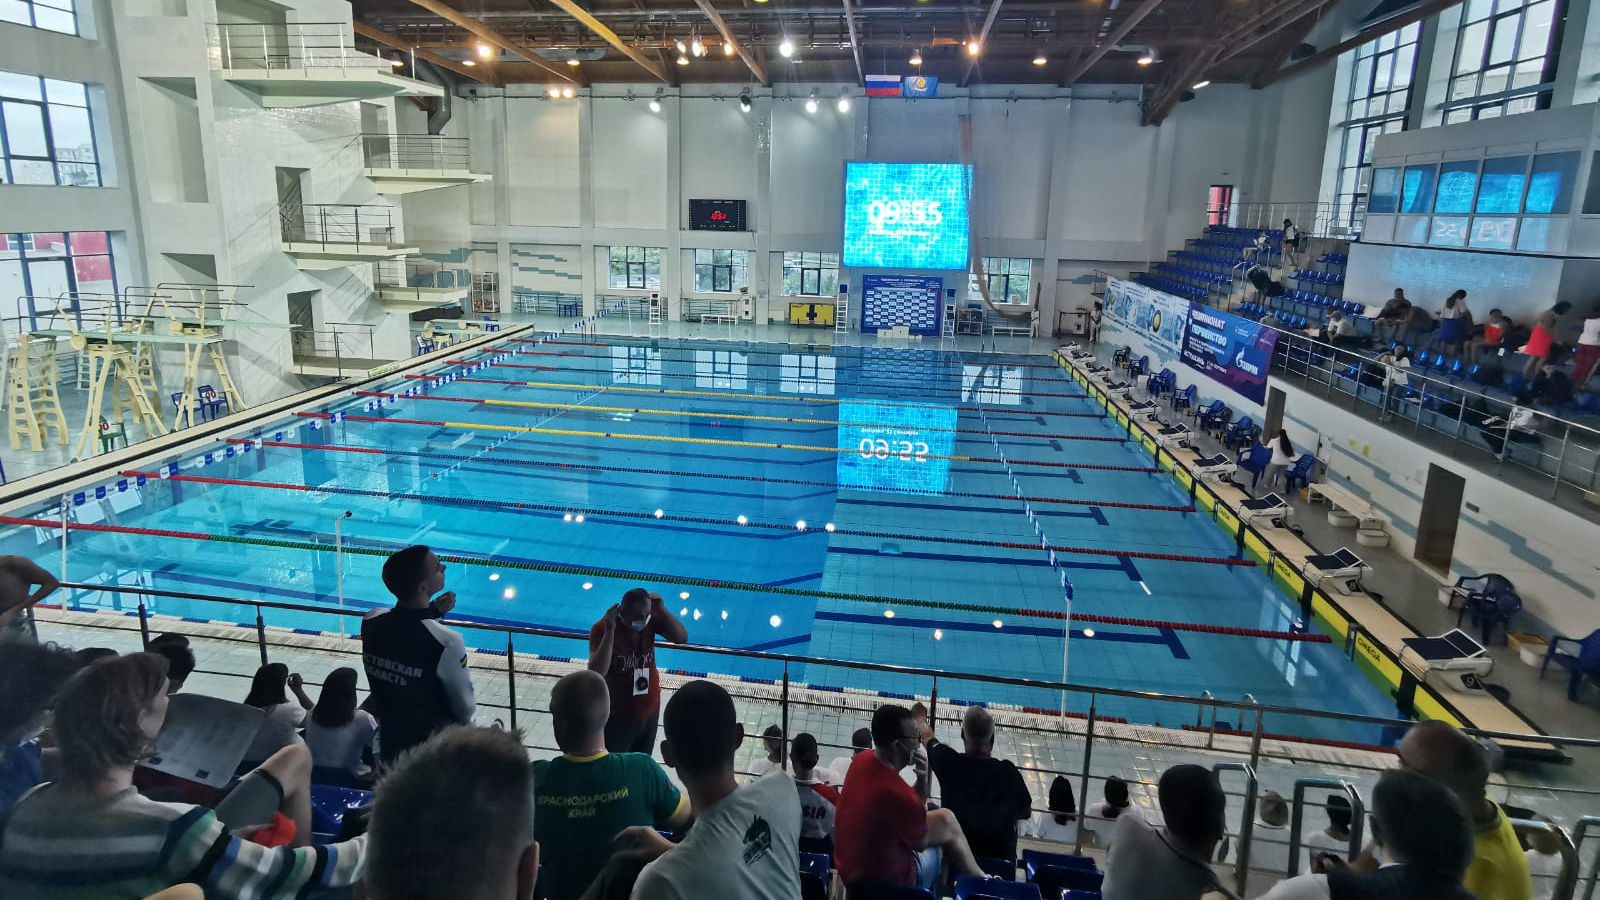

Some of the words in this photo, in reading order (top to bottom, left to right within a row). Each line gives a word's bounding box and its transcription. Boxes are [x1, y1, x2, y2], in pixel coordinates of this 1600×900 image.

[867, 201, 943, 224] 09:55
[1358, 637, 1381, 662] OMEGA
[1465, 675, 1475, 688] 9
[537, 785, 629, 806] КРАСНОДАРСКИЙ
[567, 805, 597, 819] КРАЙ
